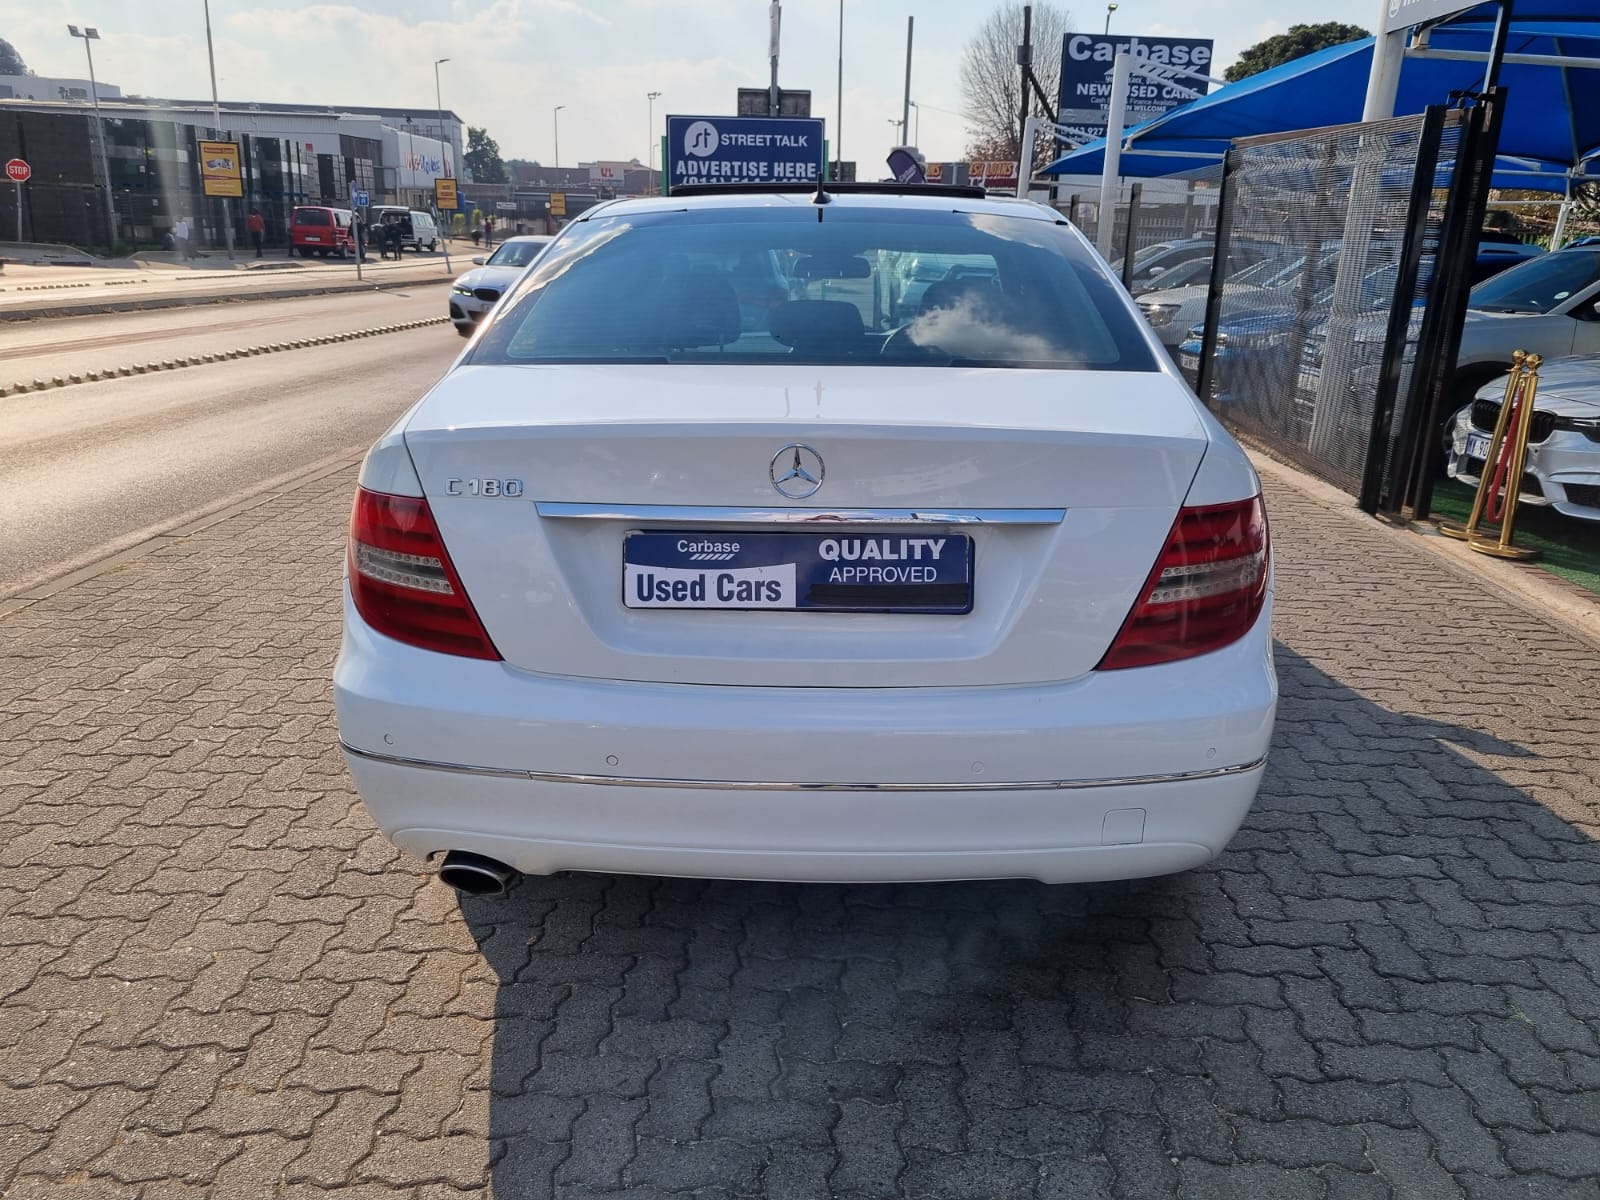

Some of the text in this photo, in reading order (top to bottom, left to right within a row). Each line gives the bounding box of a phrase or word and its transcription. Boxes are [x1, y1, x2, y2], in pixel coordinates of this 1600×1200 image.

[1068, 35, 1211, 65] Carbase
[1076, 83, 1111, 96] NEW
[720, 133, 808, 147] STREET TALK
[9, 165, 28, 175] STOP
[676, 160, 817, 178] ADVERTISE HERE
[445, 478, 523, 497] C 180
[677, 540, 741, 553] Carbase
[818, 539, 946, 562] QUALITY
[829, 567, 937, 583] APPROVED
[636, 573, 782, 602] Used Cars
